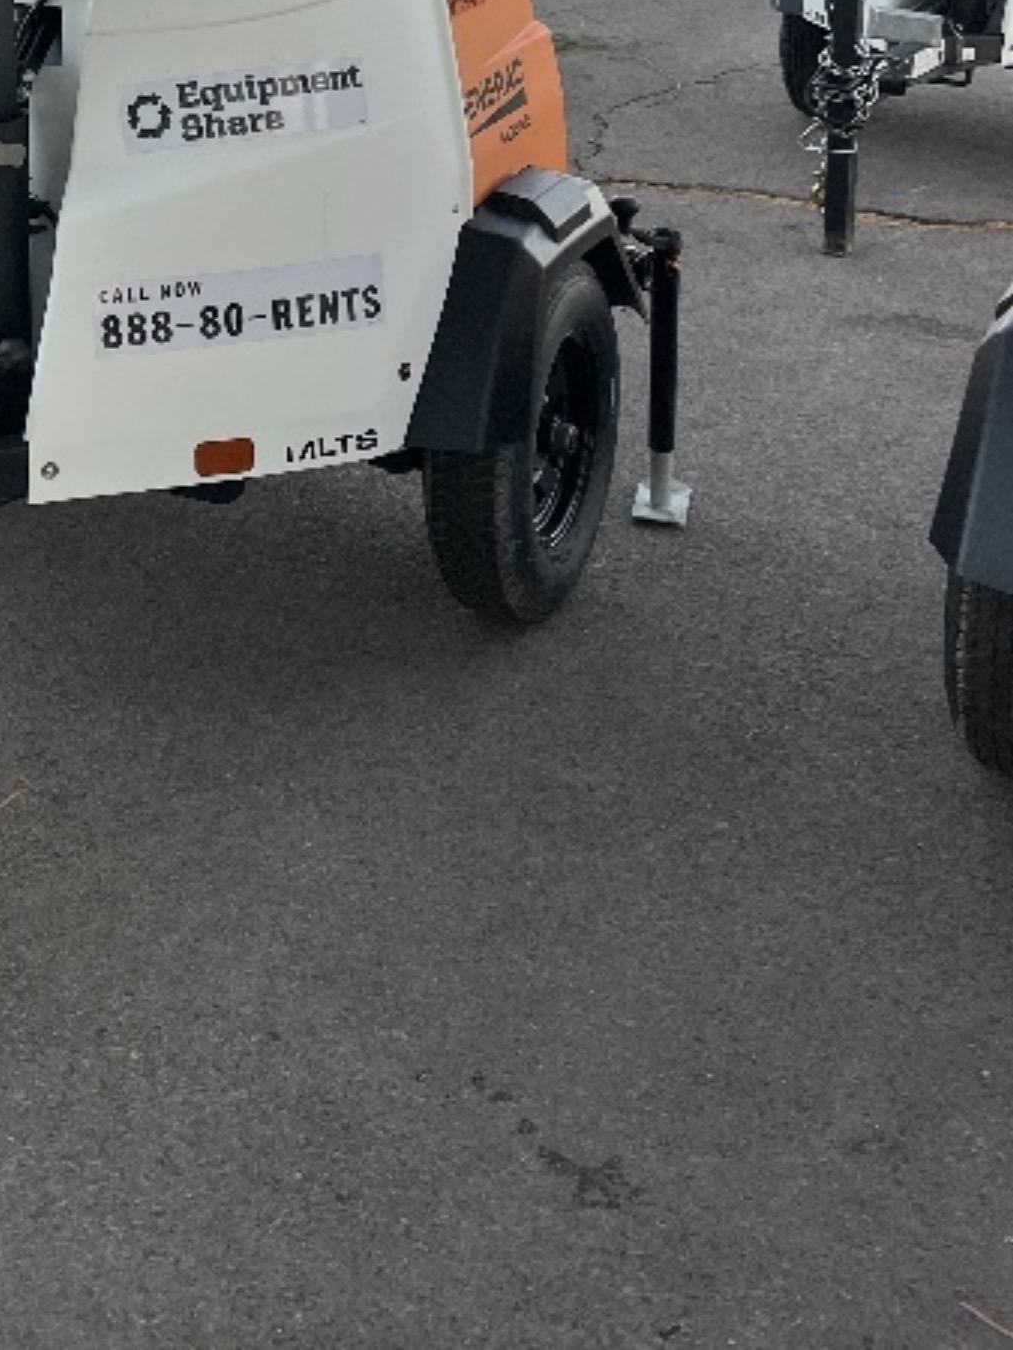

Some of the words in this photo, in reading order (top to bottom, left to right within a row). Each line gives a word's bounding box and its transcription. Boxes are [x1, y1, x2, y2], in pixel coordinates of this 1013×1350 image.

[175, 65, 363, 111] Equipment
[180, 110, 285, 141] Share
[98, 287, 150, 305] CALL
[160, 281, 202, 301] NOW
[100, 284, 383, 349] 888-80-RENTS
